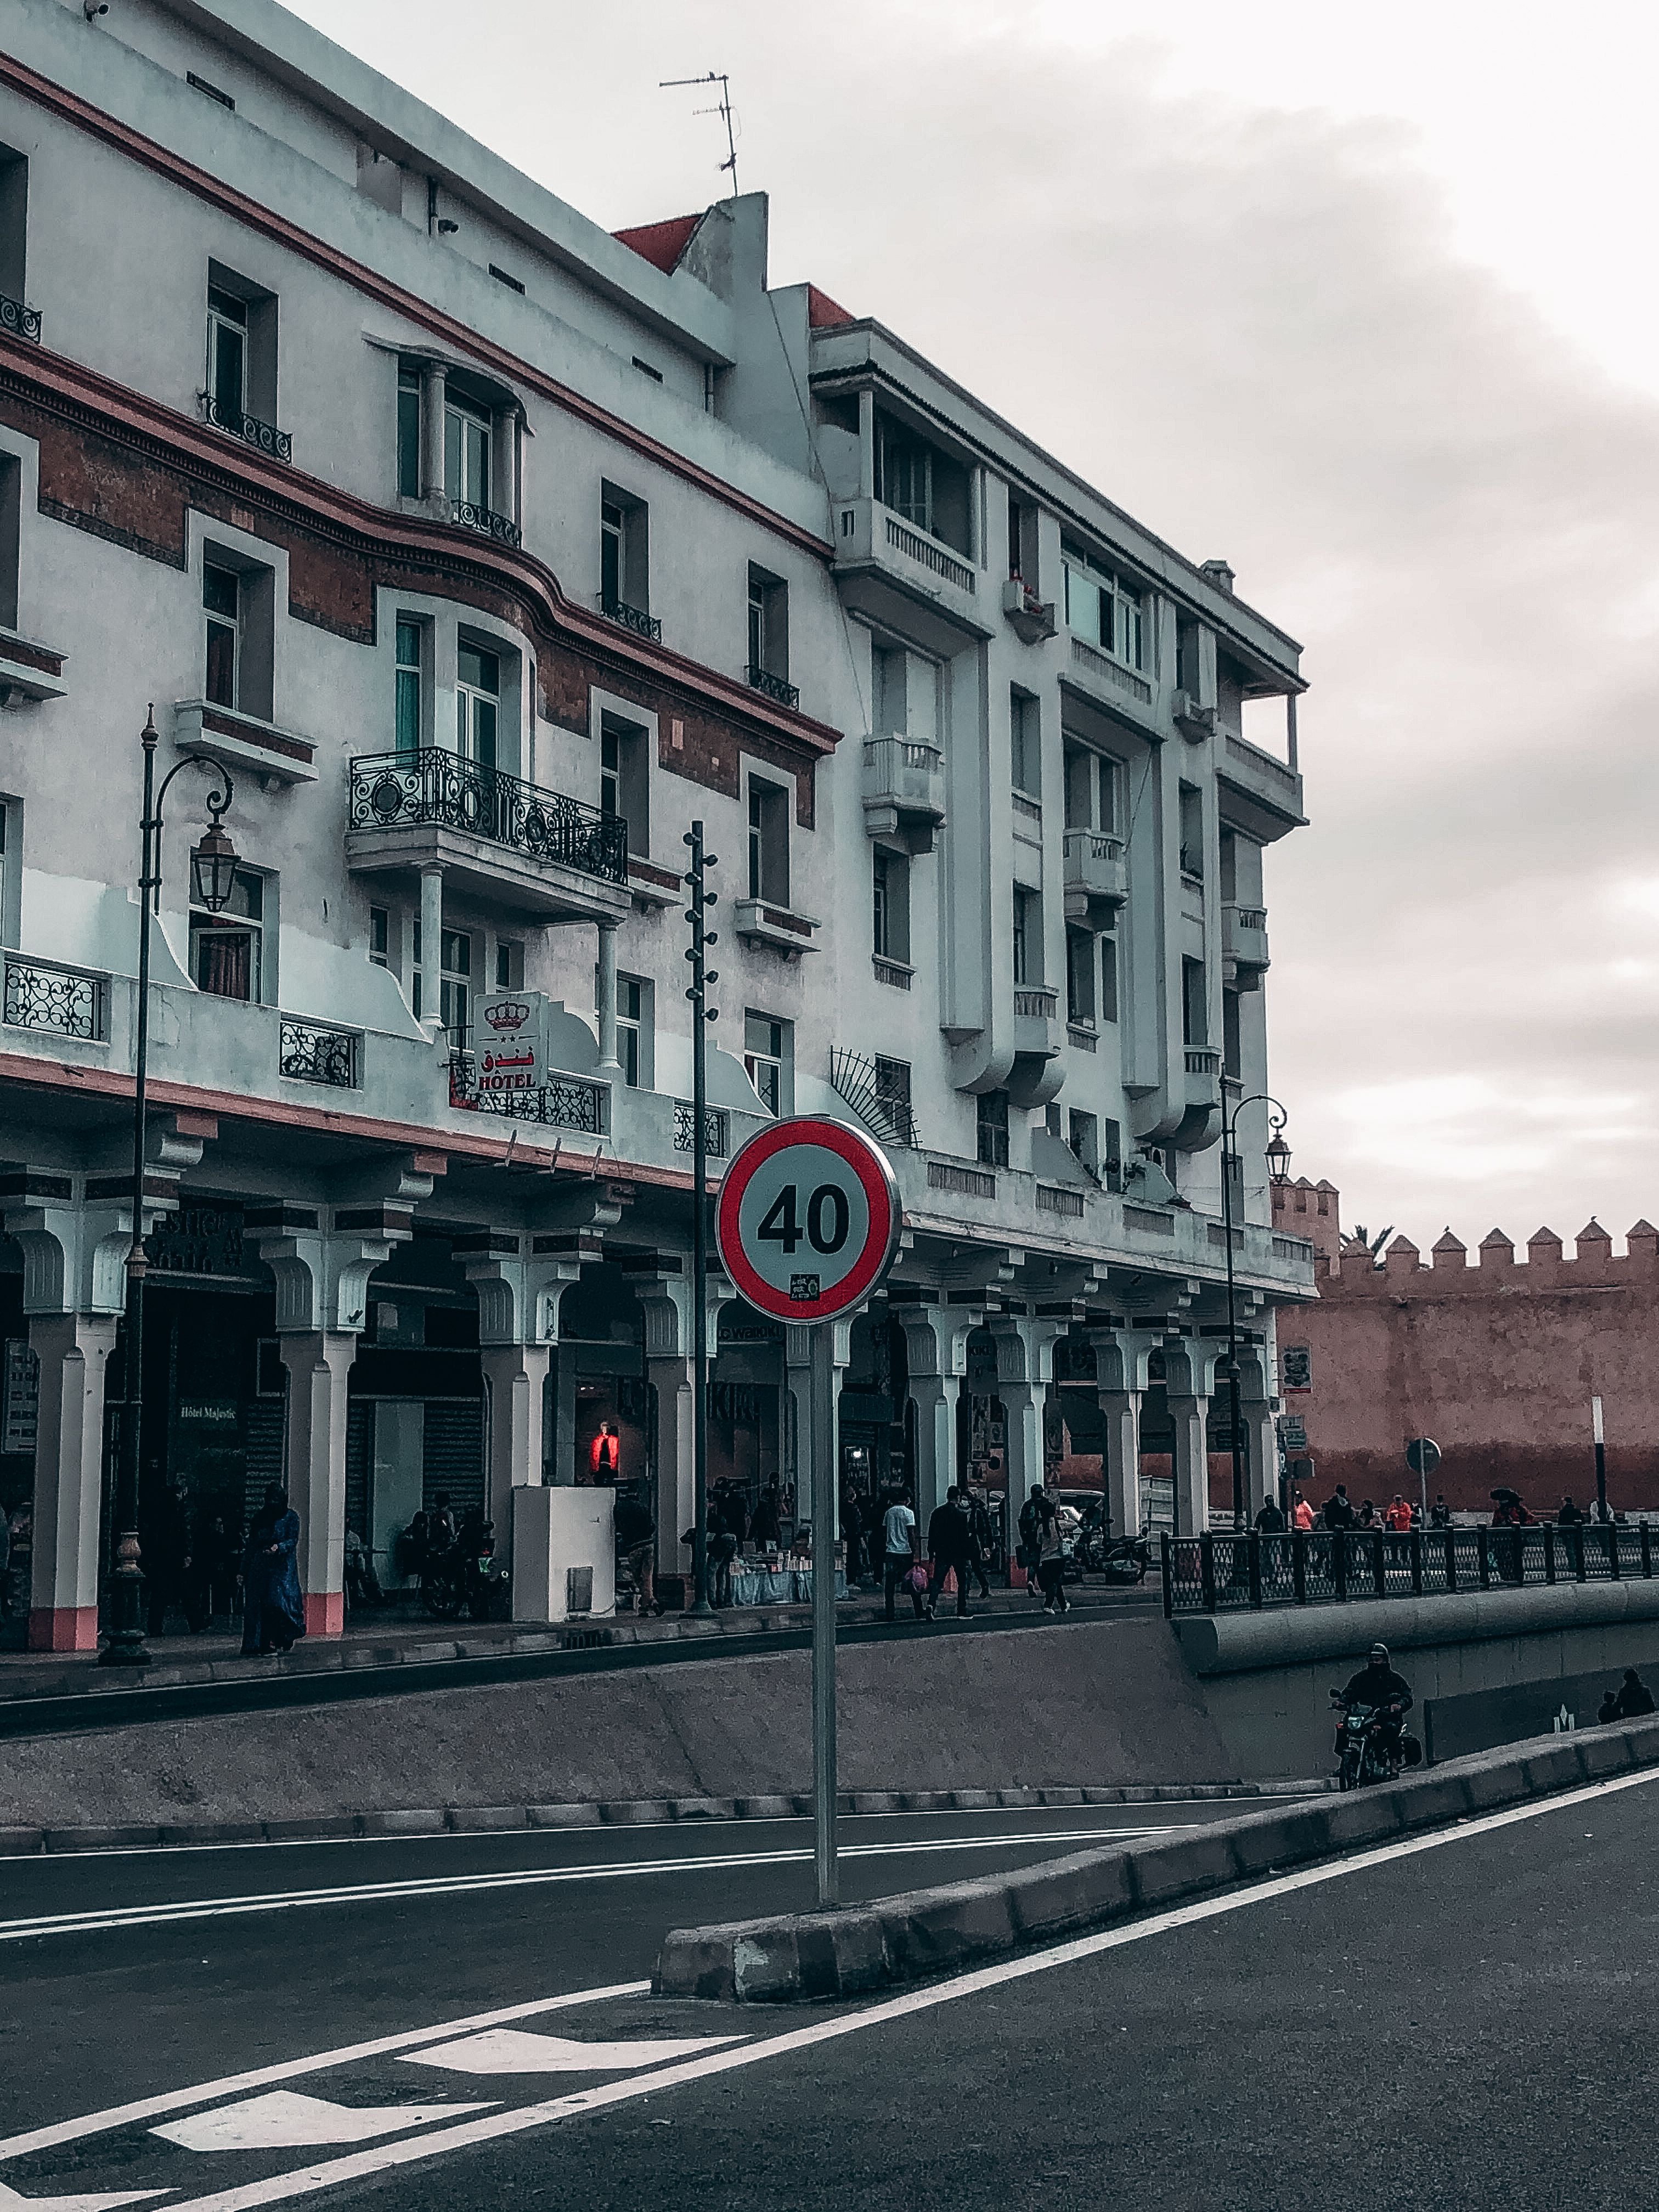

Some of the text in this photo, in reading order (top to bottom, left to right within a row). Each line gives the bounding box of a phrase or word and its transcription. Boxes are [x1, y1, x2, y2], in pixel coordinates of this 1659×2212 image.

[481, 1045, 535, 1073] فندق
[478, 1069, 537, 1091] HÔTEL
[757, 1184, 850, 1255] 40
